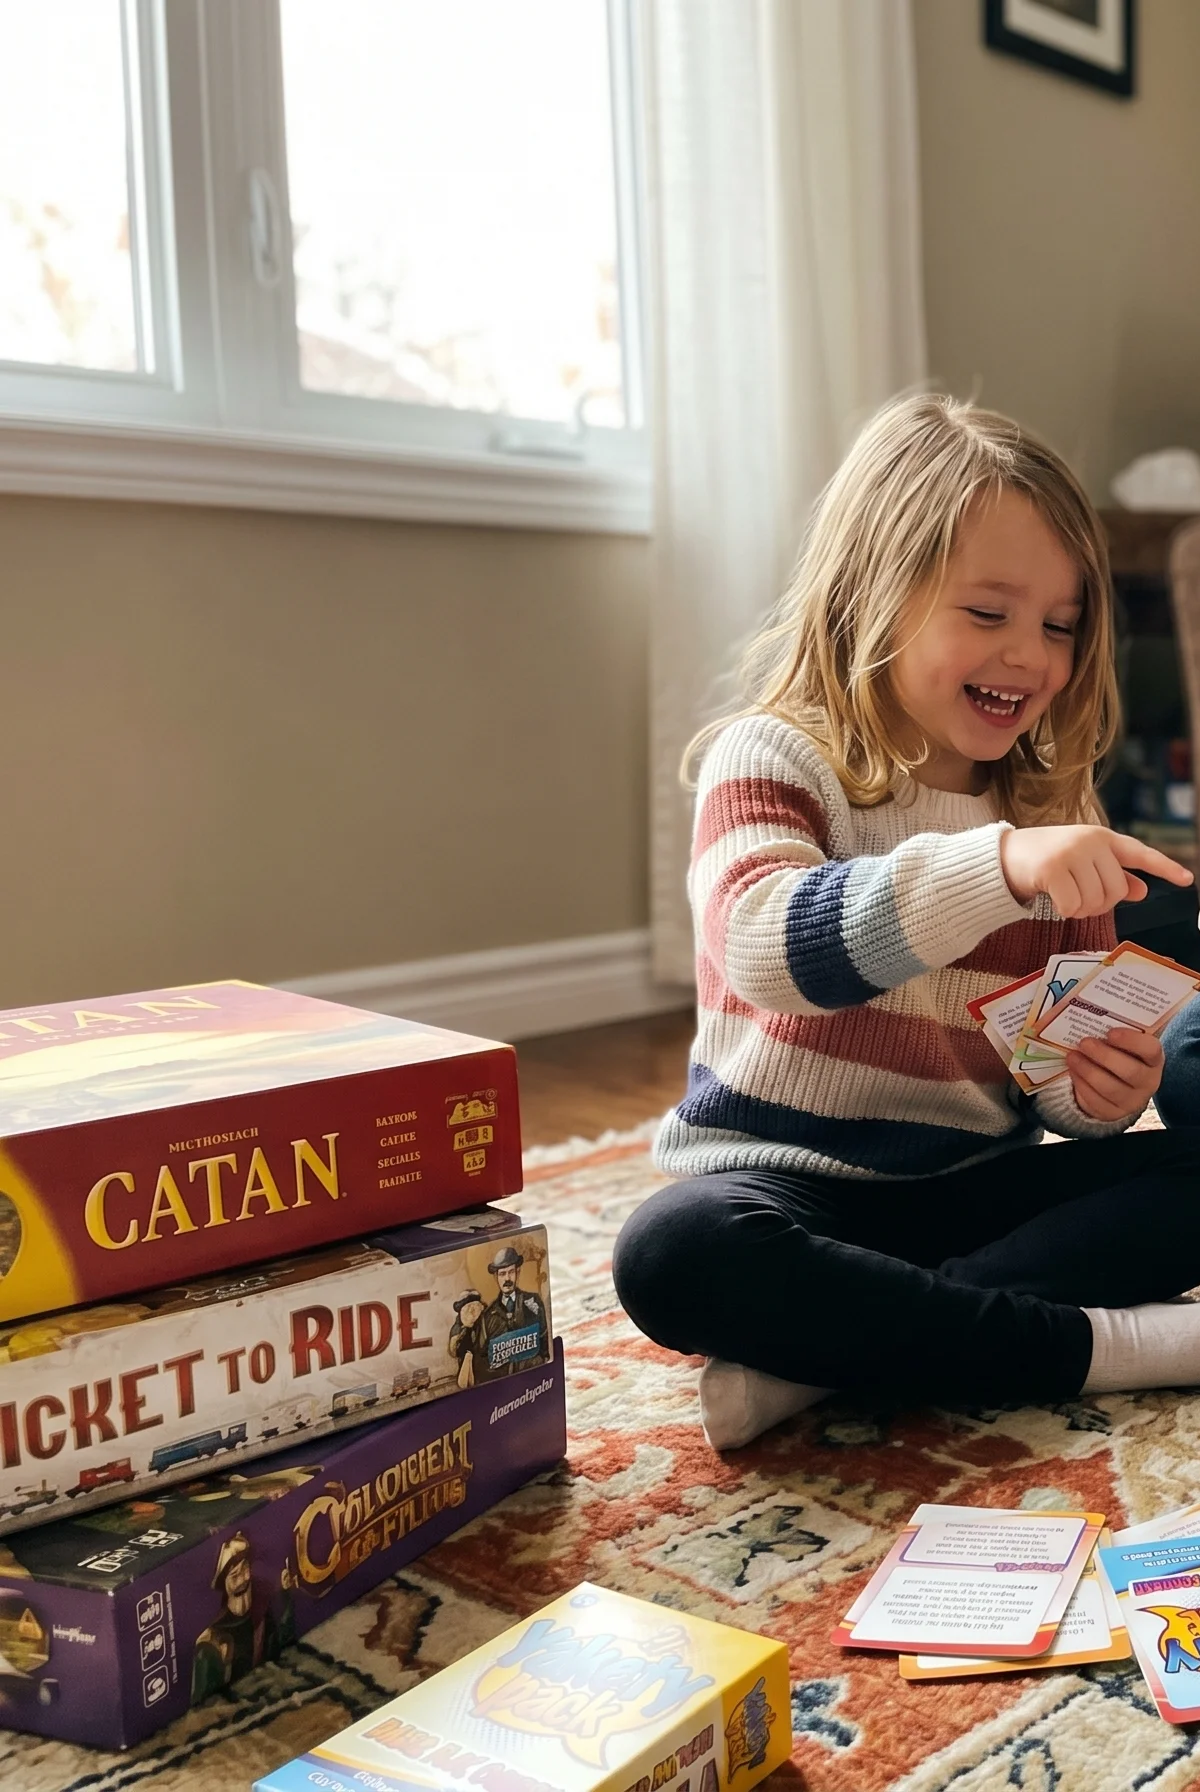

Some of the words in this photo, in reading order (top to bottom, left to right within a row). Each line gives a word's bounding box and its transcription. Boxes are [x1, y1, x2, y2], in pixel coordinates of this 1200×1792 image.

[0, 995, 222, 1038] TAN
[84, 1132, 340, 1251] CATAN
[217, 1340, 276, 1395] TO
[288, 1291, 434, 1379] RIDE
